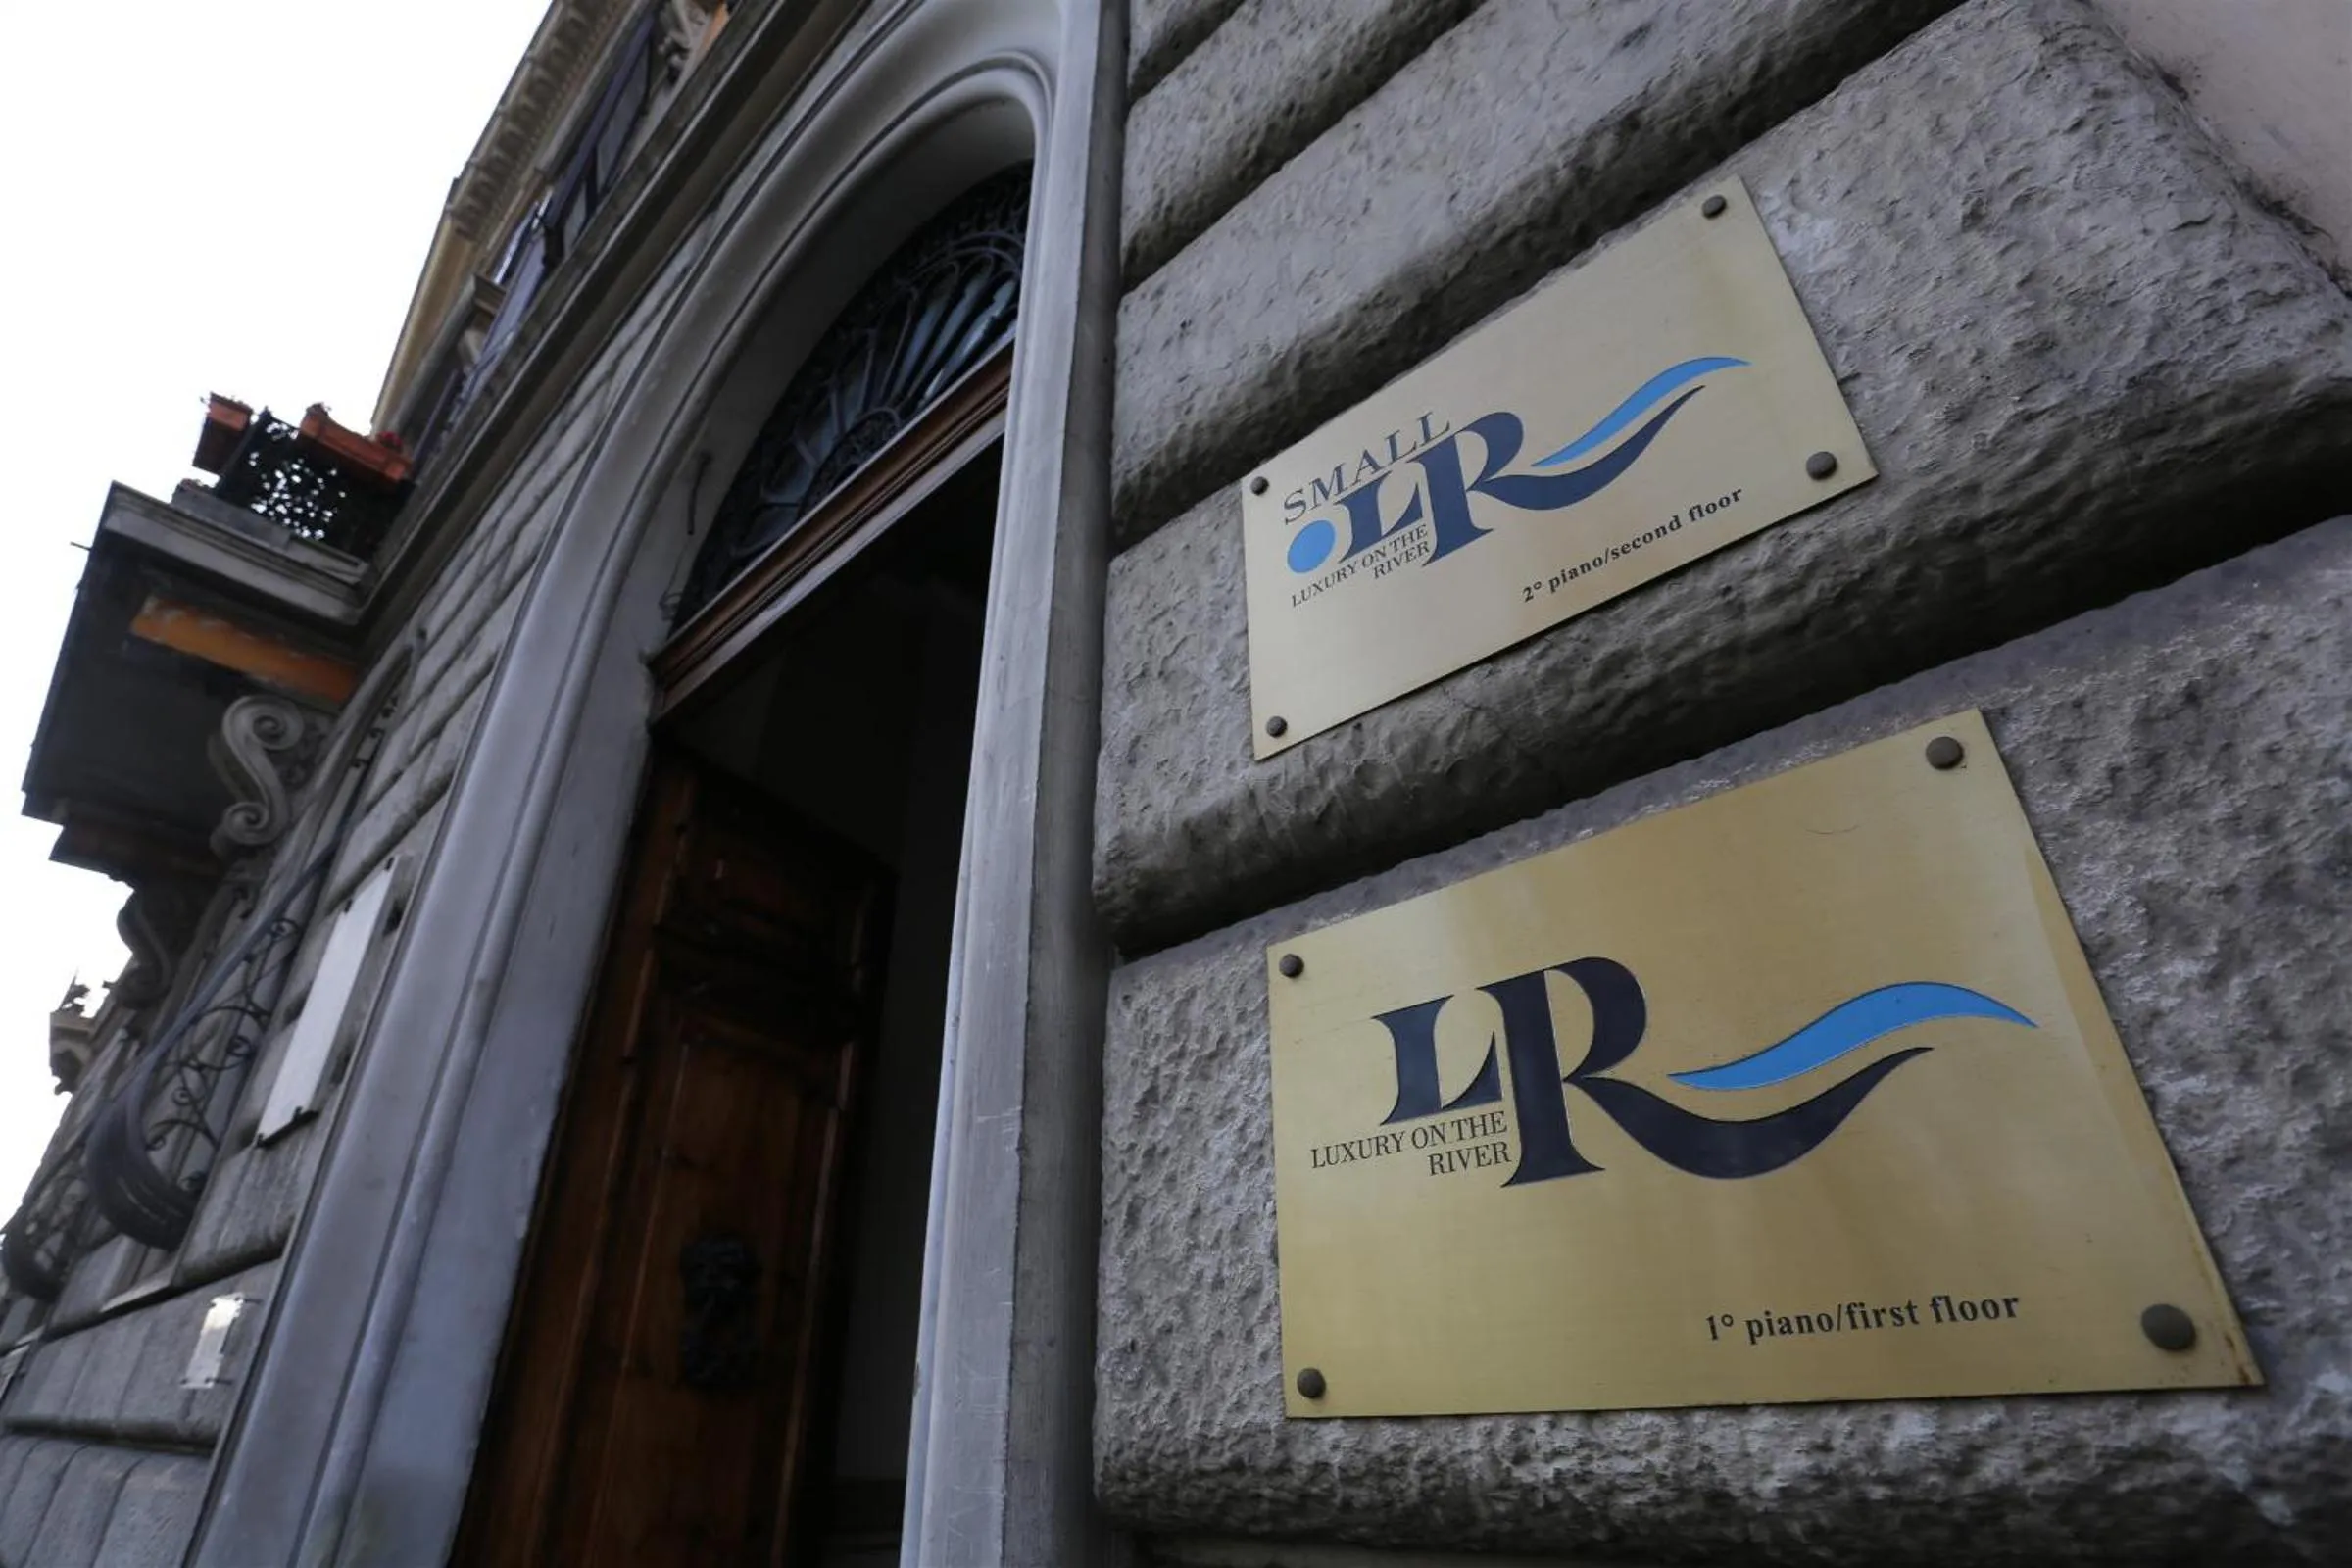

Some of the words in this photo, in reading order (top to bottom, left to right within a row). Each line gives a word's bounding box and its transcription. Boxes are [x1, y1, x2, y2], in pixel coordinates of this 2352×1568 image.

[1284, 412, 1450, 525] SMALL
[1291, 561, 1358, 608] LUXURY
[1362, 545, 1387, 568] ON
[1389, 524, 1429, 554] THE
[1374, 541, 1431, 580] RIVER
[1548, 514, 1683, 593] piano/second
[1687, 488, 1743, 523] floor
[1309, 1131, 1405, 1169] LUXURY
[1411, 1121, 1446, 1150] ON
[1449, 1110, 1508, 1142] THE
[1428, 1141, 1512, 1176] RIVER
[1744, 1299, 1920, 1346] piano/first
[1929, 1294, 2020, 1324] floor
